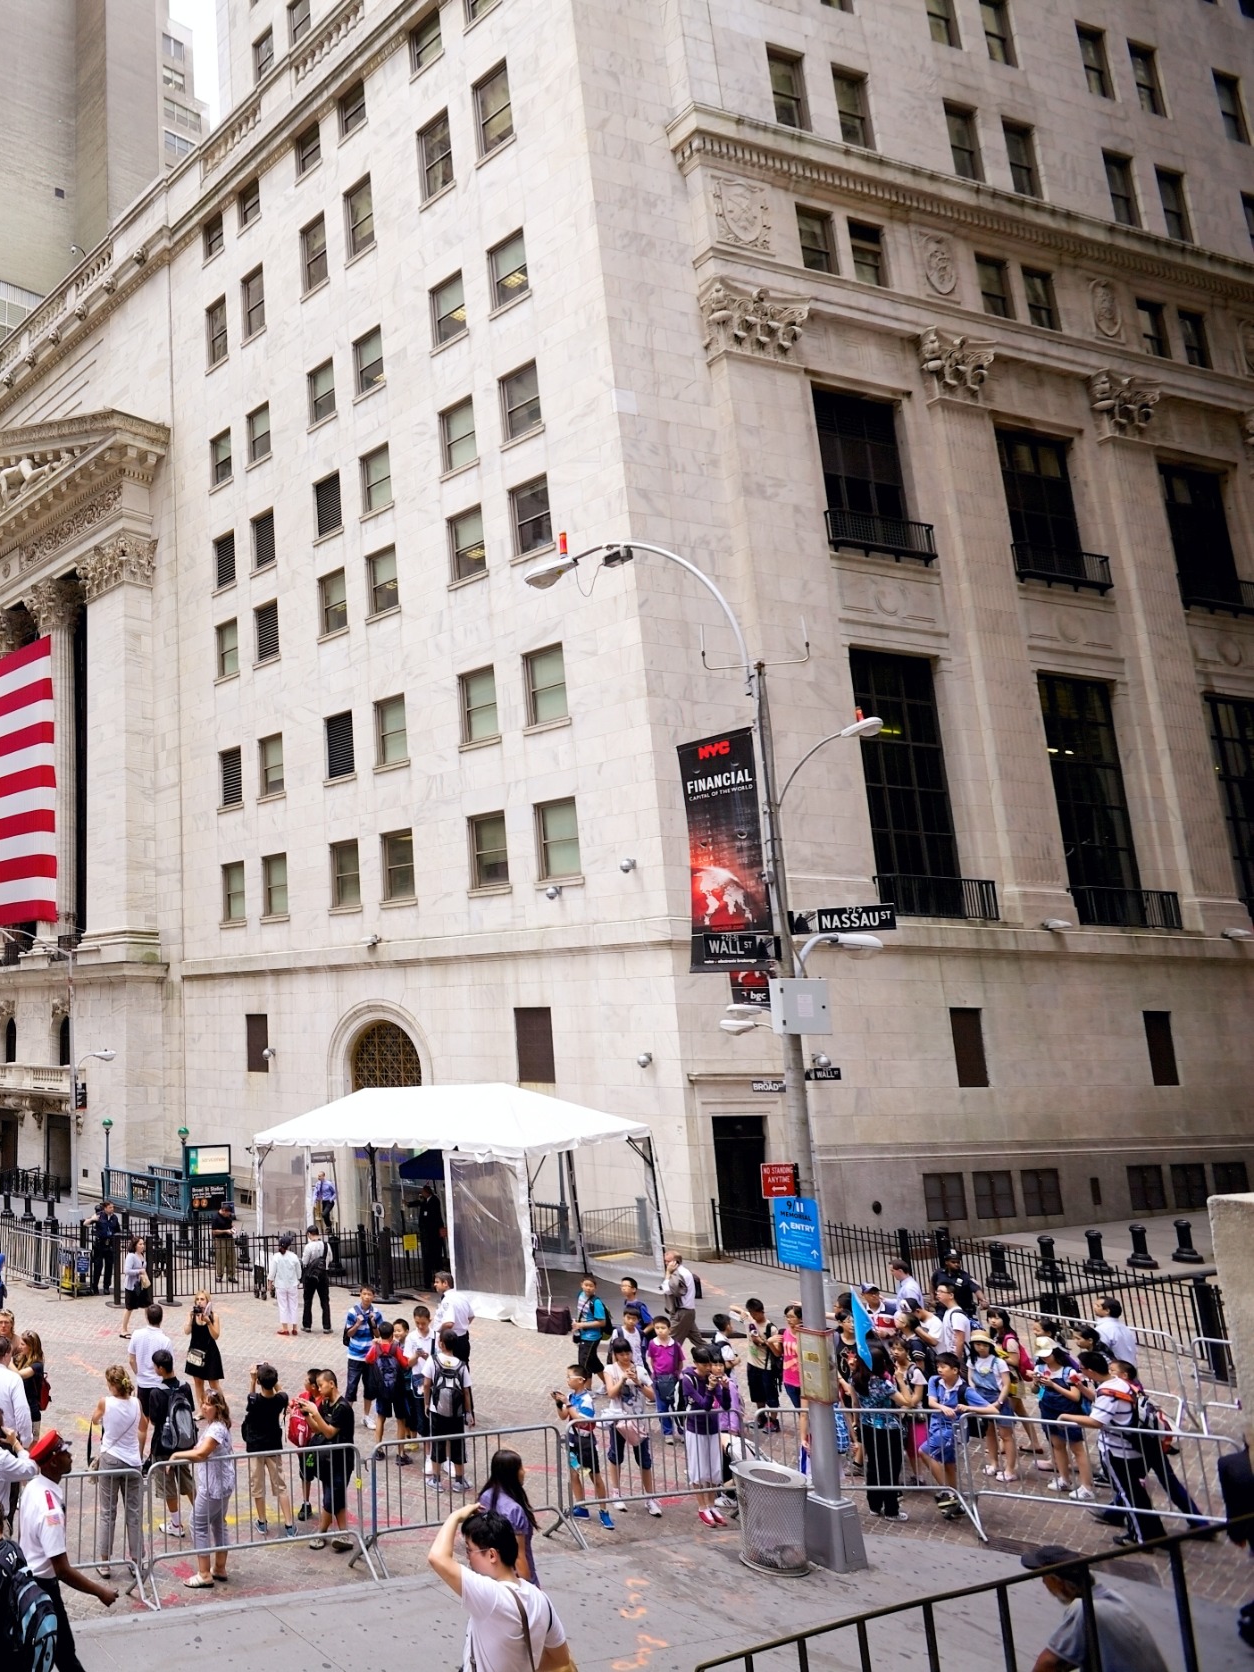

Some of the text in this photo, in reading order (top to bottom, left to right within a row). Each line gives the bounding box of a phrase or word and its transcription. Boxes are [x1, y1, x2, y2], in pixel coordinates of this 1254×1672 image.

[698, 741, 730, 760] NYC
[686, 768, 752, 794] FINANCIAL
[689, 794, 710, 802] CAPITAL
[821, 910, 891, 929] NASSAU ST
[708, 940, 744, 954] WALL
[750, 991, 766, 1001] bgc
[131, 1176, 147, 1186] Subway
[786, 1200, 804, 1212] 9/11
[780, 1211, 812, 1221] MEMORIAL
[790, 1222, 814, 1233] ENTRY
